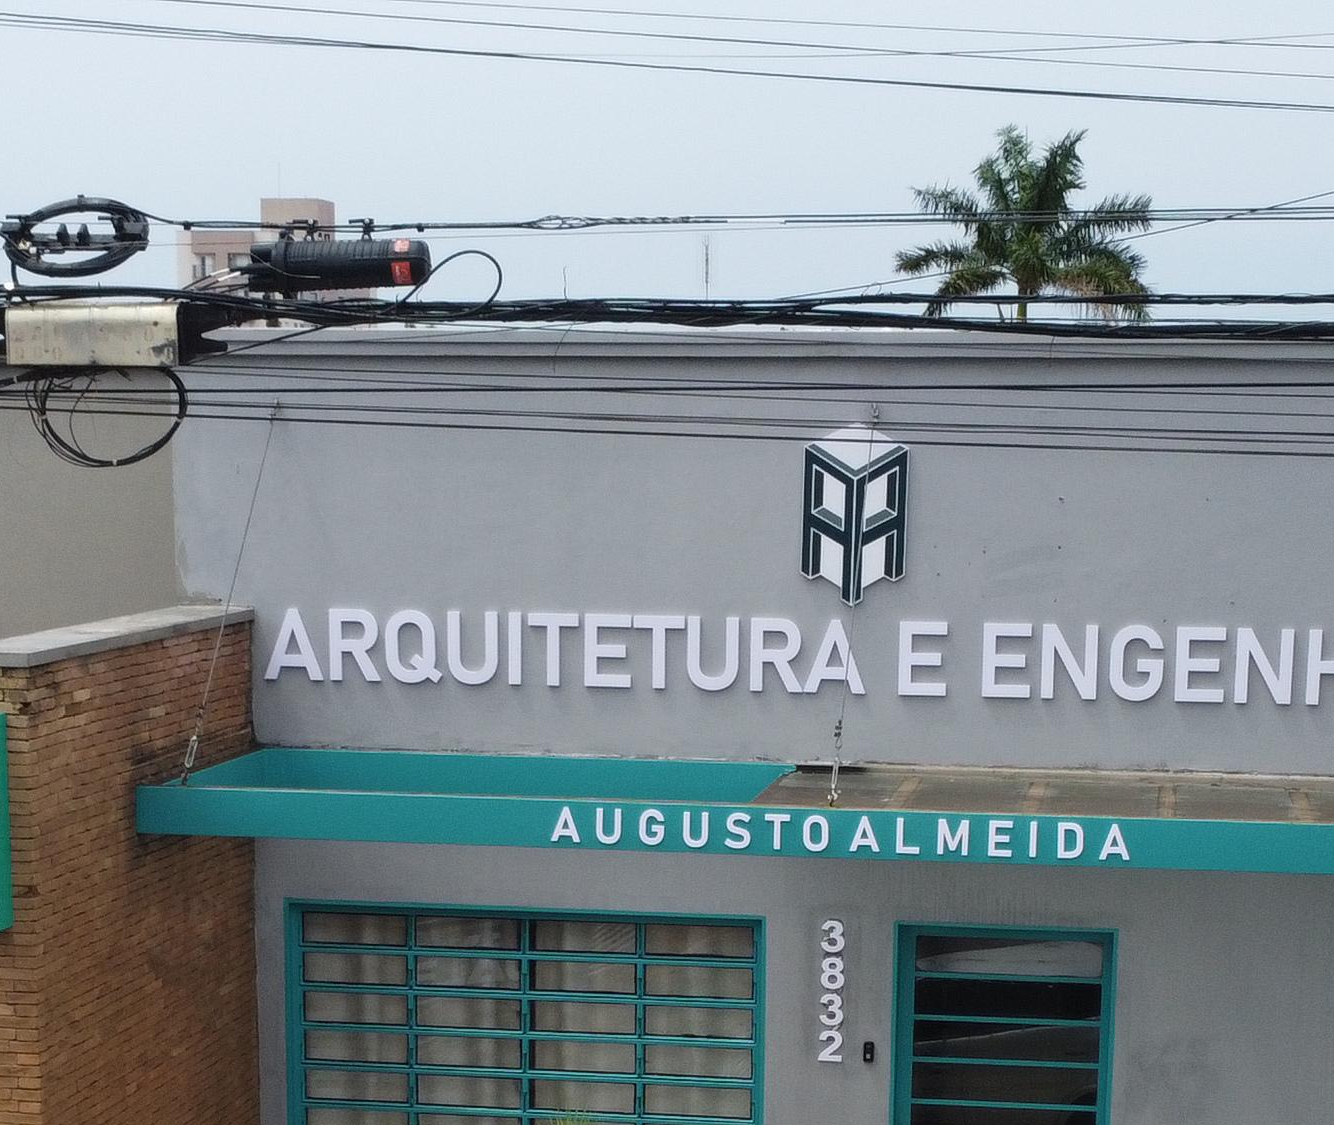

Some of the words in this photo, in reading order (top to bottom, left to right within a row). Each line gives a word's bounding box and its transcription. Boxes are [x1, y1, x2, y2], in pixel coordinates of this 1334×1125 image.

[266, 607, 866, 695] ARQUITETURA
[897, 620, 949, 697] E
[551, 806, 830, 852] AUGUSTO
[848, 815, 1131, 861] ALMEIDA
[817, 920, 845, 1062] 3832
